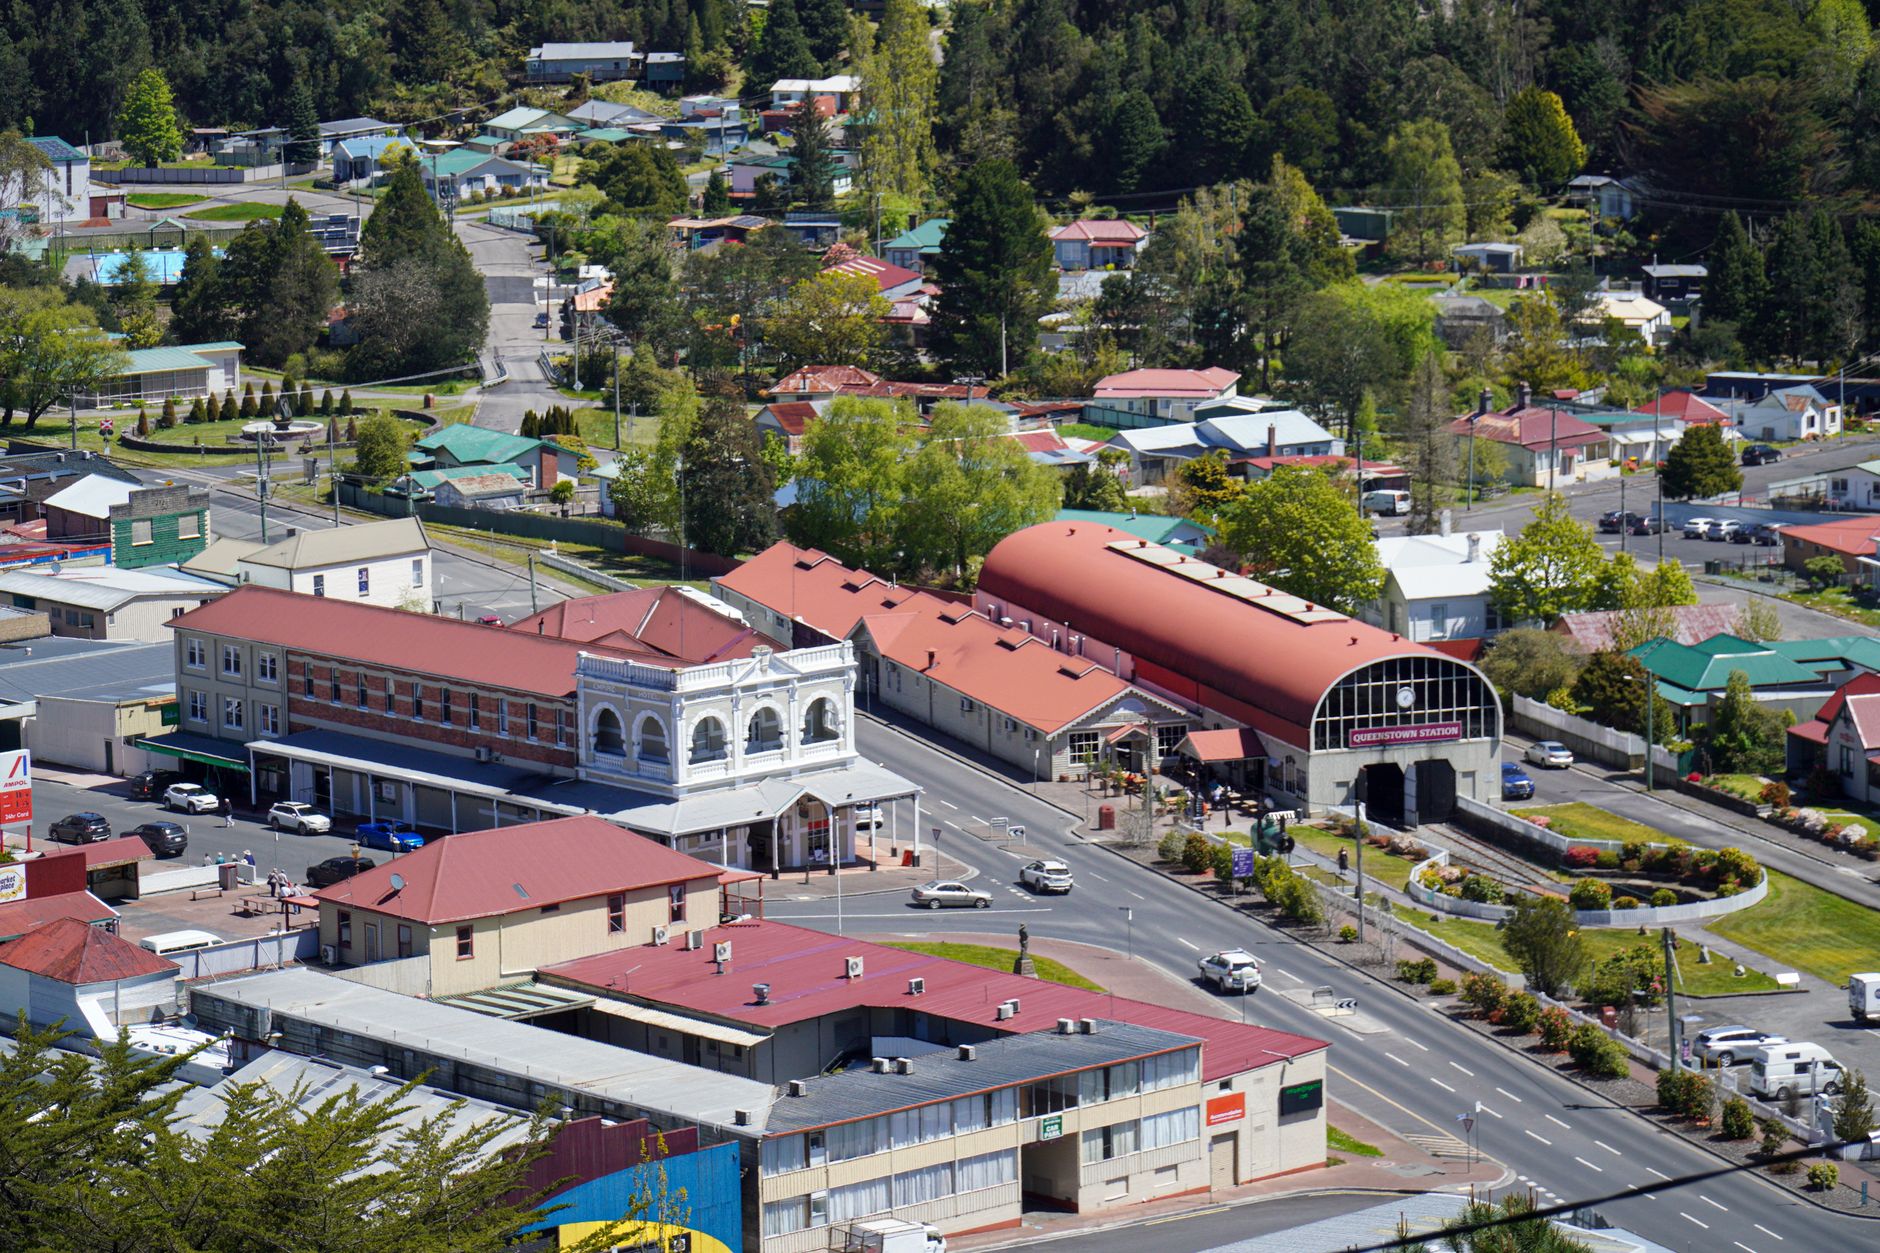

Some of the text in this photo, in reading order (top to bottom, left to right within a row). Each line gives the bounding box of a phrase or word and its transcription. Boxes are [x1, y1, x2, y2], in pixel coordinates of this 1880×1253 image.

[1353, 726, 1459, 743] QUEENSTOWN STATION
[3, 780, 28, 788] AMPOL
